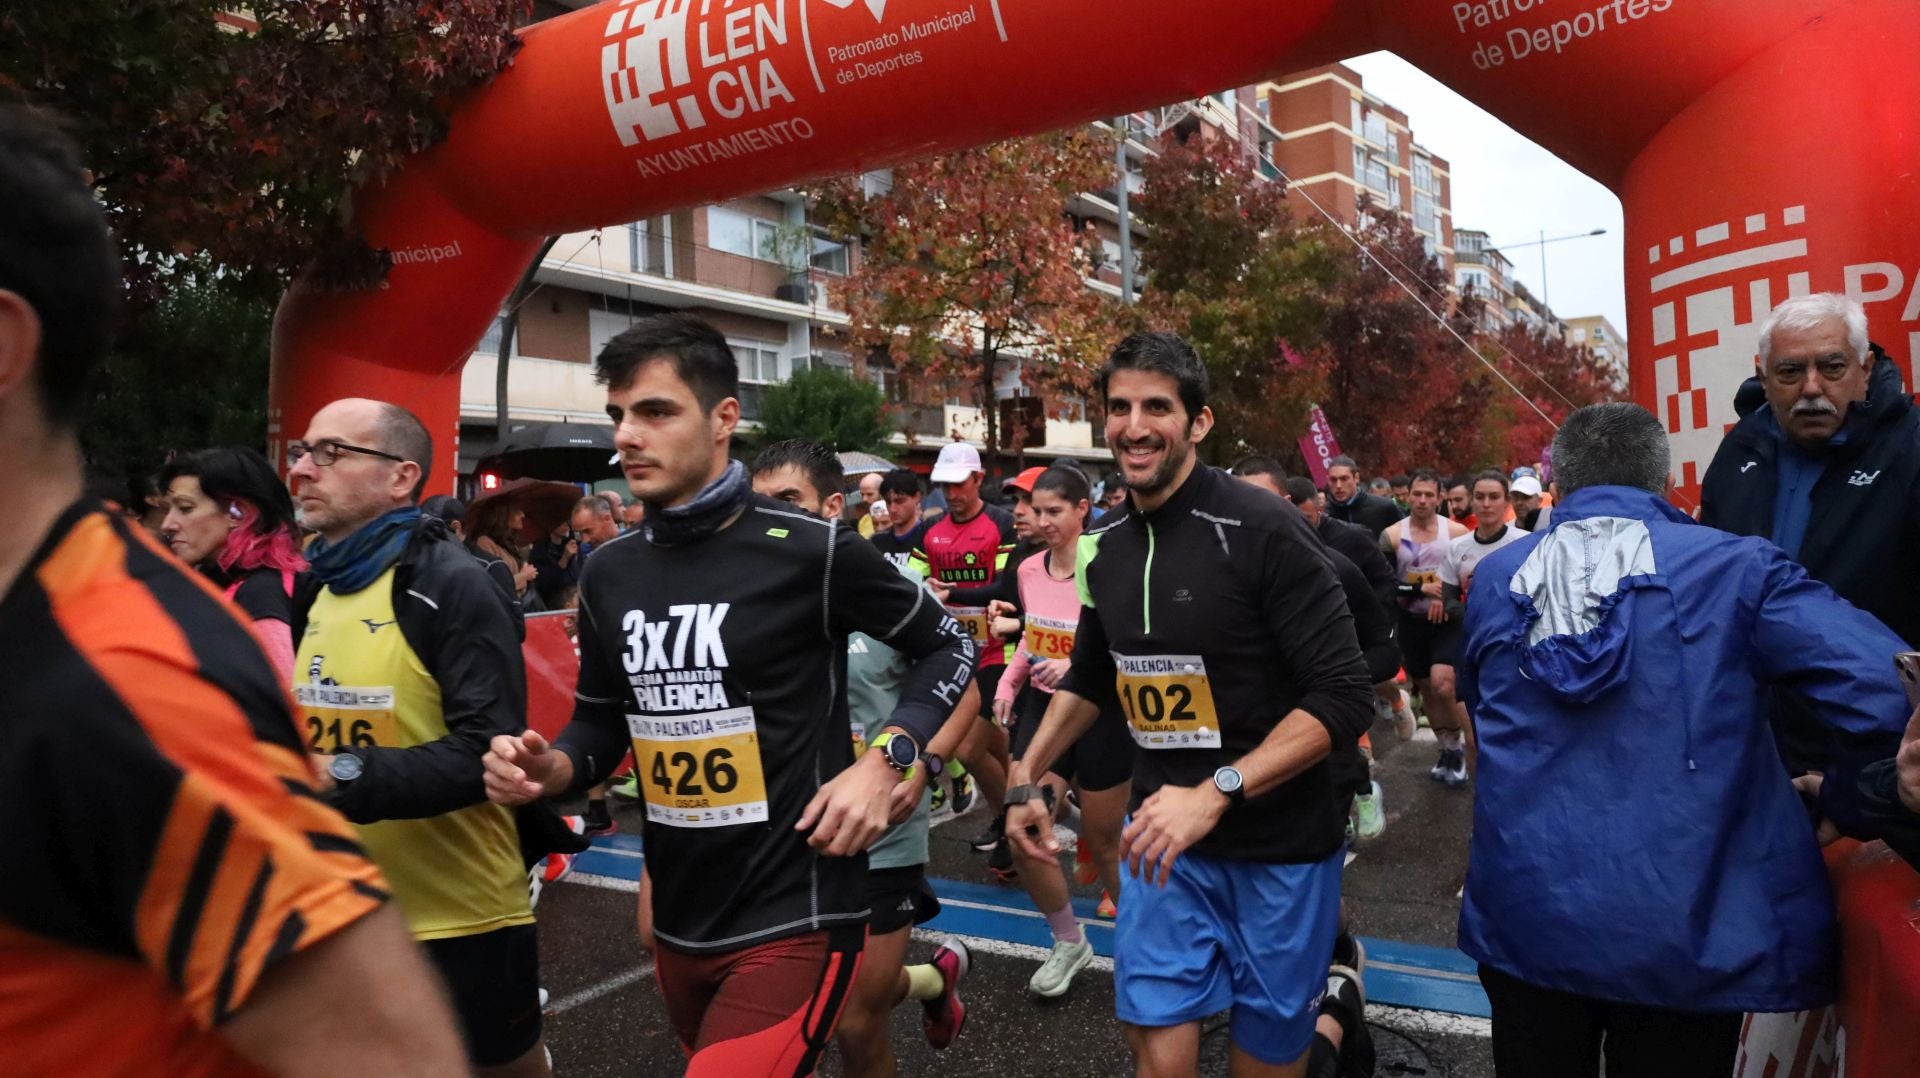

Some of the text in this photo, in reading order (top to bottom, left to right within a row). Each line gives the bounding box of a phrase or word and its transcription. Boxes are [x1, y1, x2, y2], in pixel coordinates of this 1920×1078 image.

[828, 5, 976, 64] Patronato Municipal
[1453, 0, 1546, 33] Patro
[1472, 0, 1673, 70] de Deportes
[836, 48, 924, 85] de Deportes
[708, 59, 795, 119] CIA
[636, 117, 814, 179] AYUNTAMIENTO
[390, 240, 463, 265] nicipal
[622, 603, 730, 674] 3x7K
[1033, 630, 1072, 655] 736
[628, 666, 723, 687] MEDIA MARATÓN
[1123, 659, 1175, 673] PALENCIA
[633, 682, 730, 712] PALENCIA
[1123, 683, 1197, 722] 102
[307, 715, 377, 752] 216
[655, 718, 714, 737] PALENCIA
[652, 747, 738, 796] 426
[676, 798, 711, 809] OSCAR
